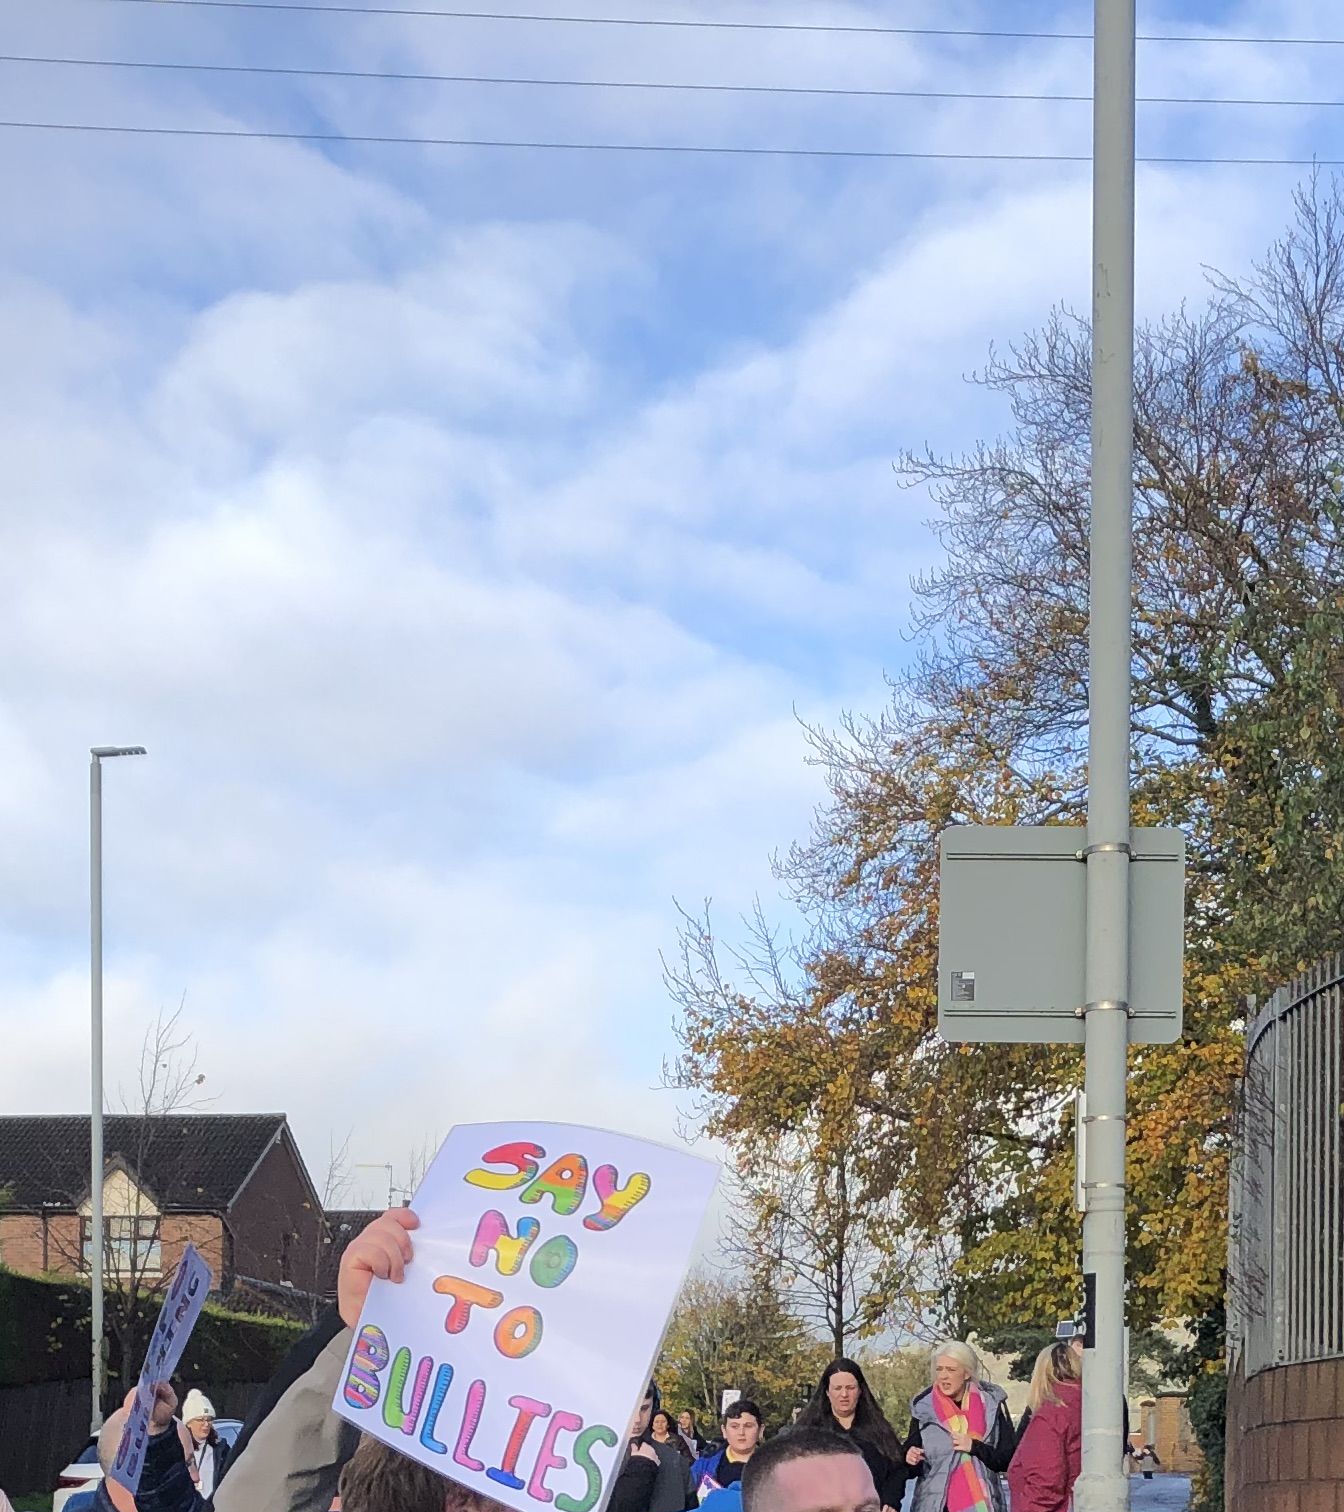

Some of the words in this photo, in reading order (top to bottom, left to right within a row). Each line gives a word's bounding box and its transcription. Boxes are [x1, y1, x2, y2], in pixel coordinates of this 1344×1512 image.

[463, 1142, 651, 1232] SAY
[468, 1209, 579, 1289] NO
[432, 1274, 544, 1359] TO
